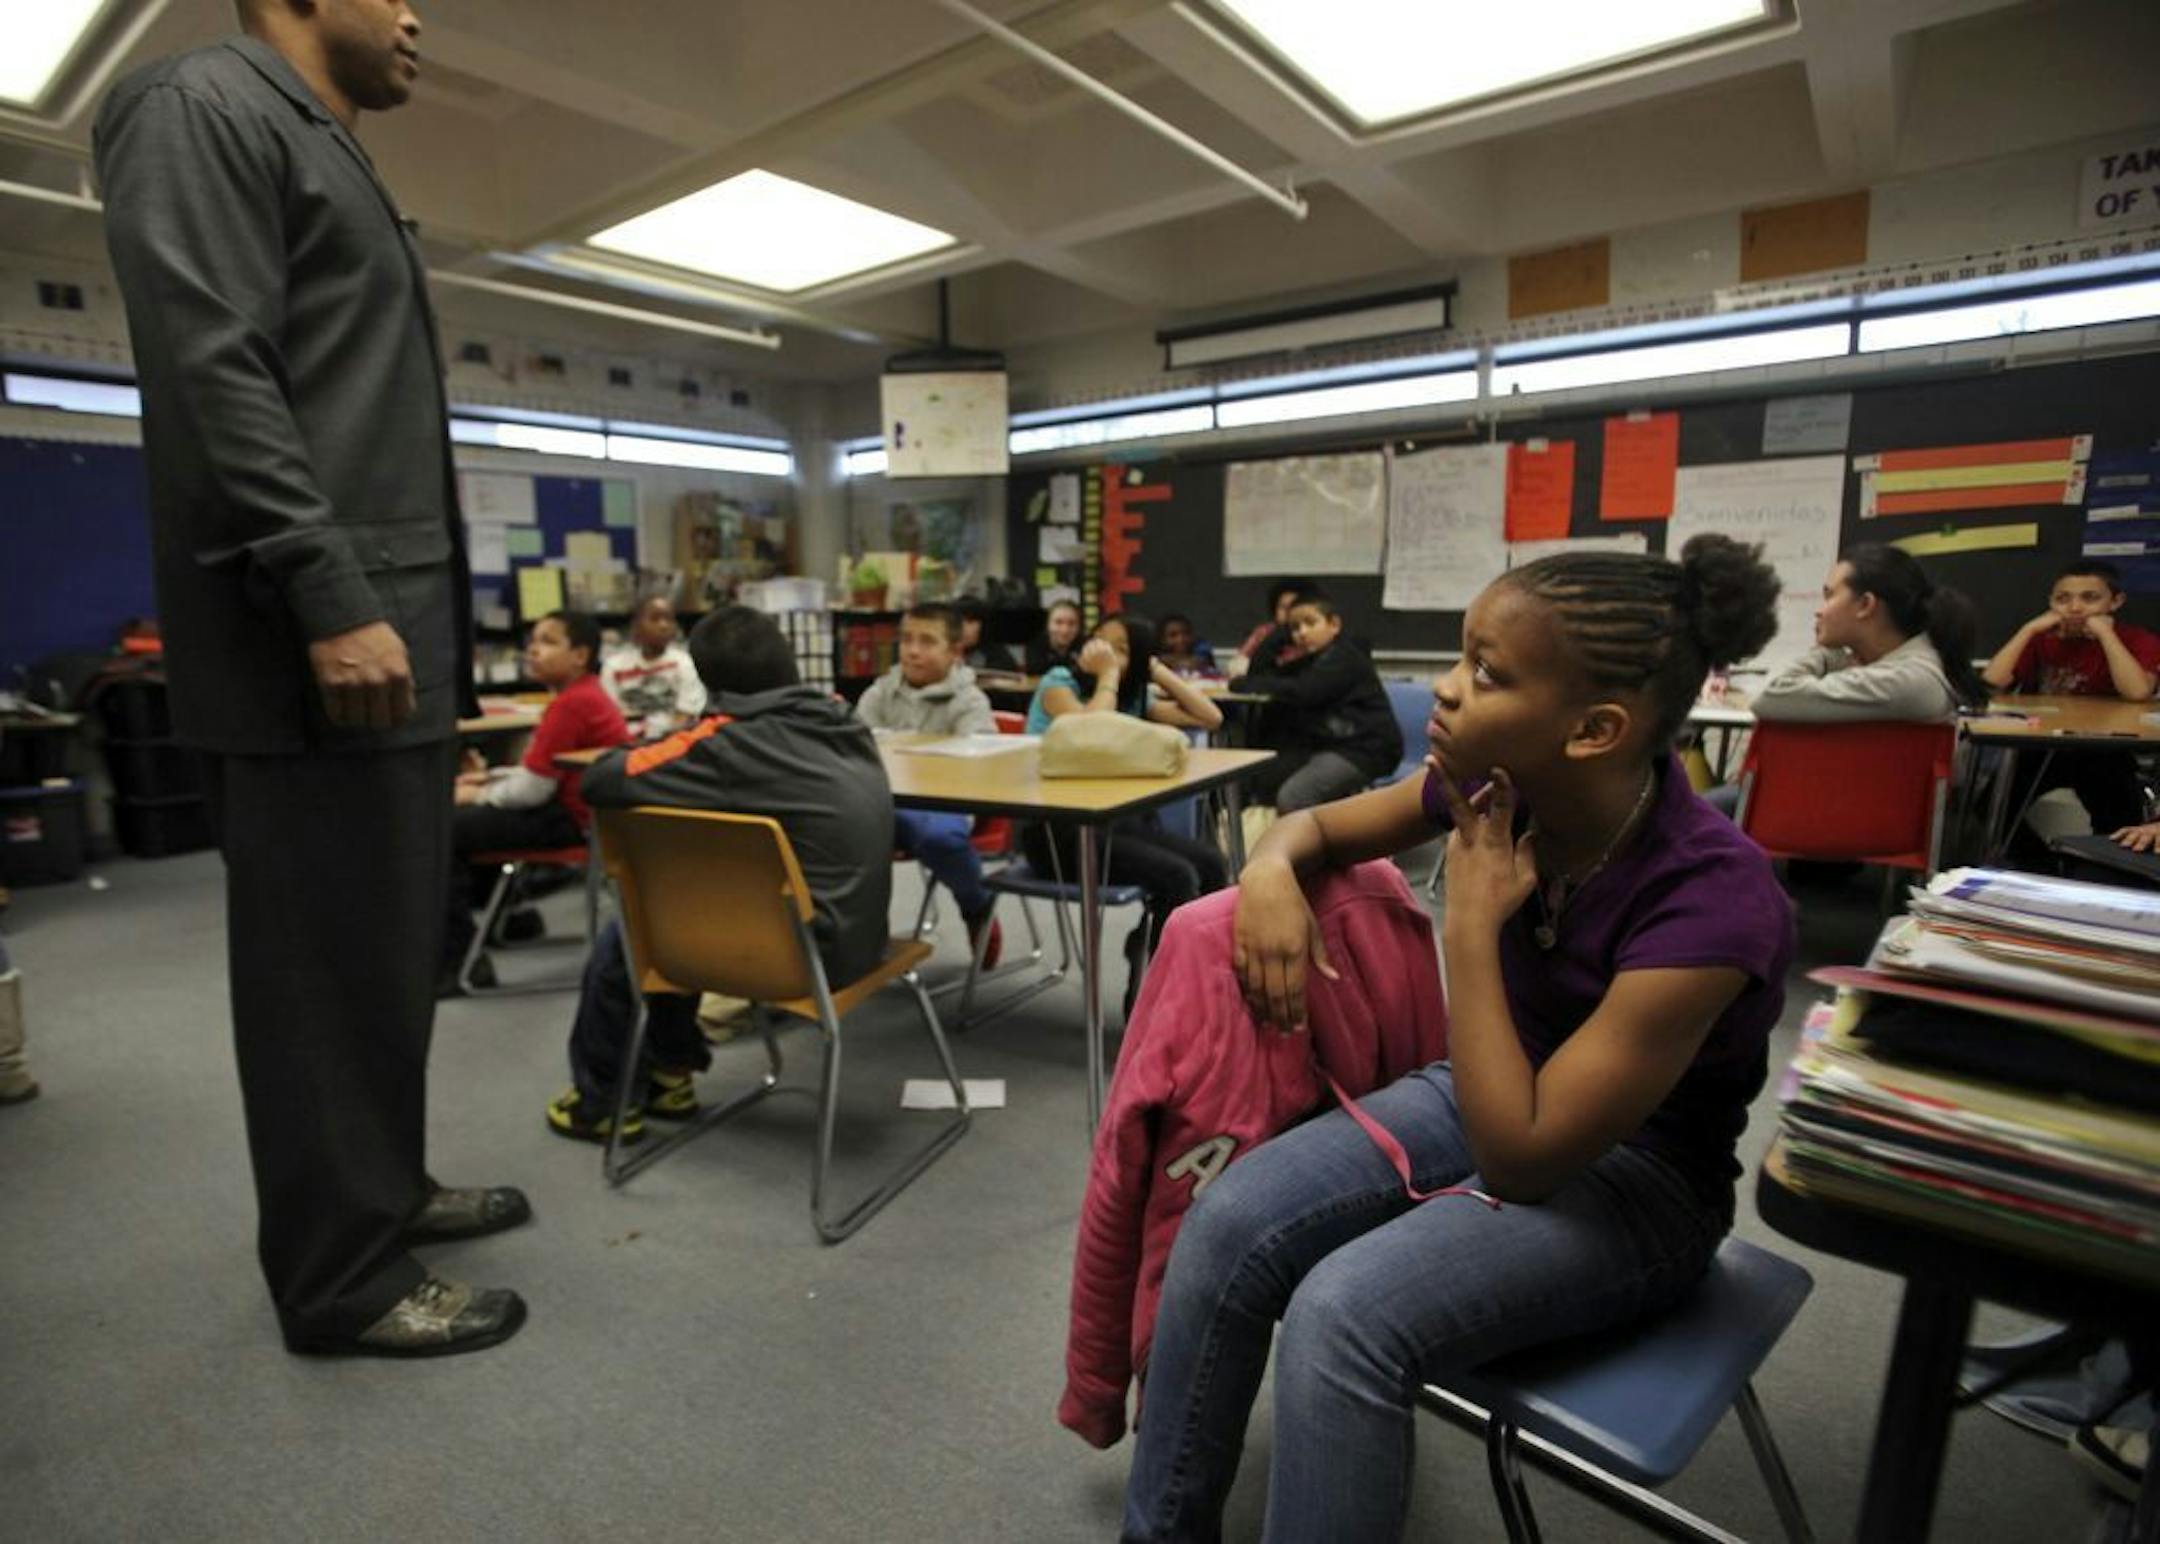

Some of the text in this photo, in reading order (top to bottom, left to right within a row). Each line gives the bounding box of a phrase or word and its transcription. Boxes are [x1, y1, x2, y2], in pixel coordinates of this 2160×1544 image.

[2096, 188, 2143, 218] OF
[1987, 260, 2007, 275] 132
[2018, 256, 2039, 271] 133
[2048, 251, 2069, 265] 134
[1165, 1134, 1238, 1200] A
